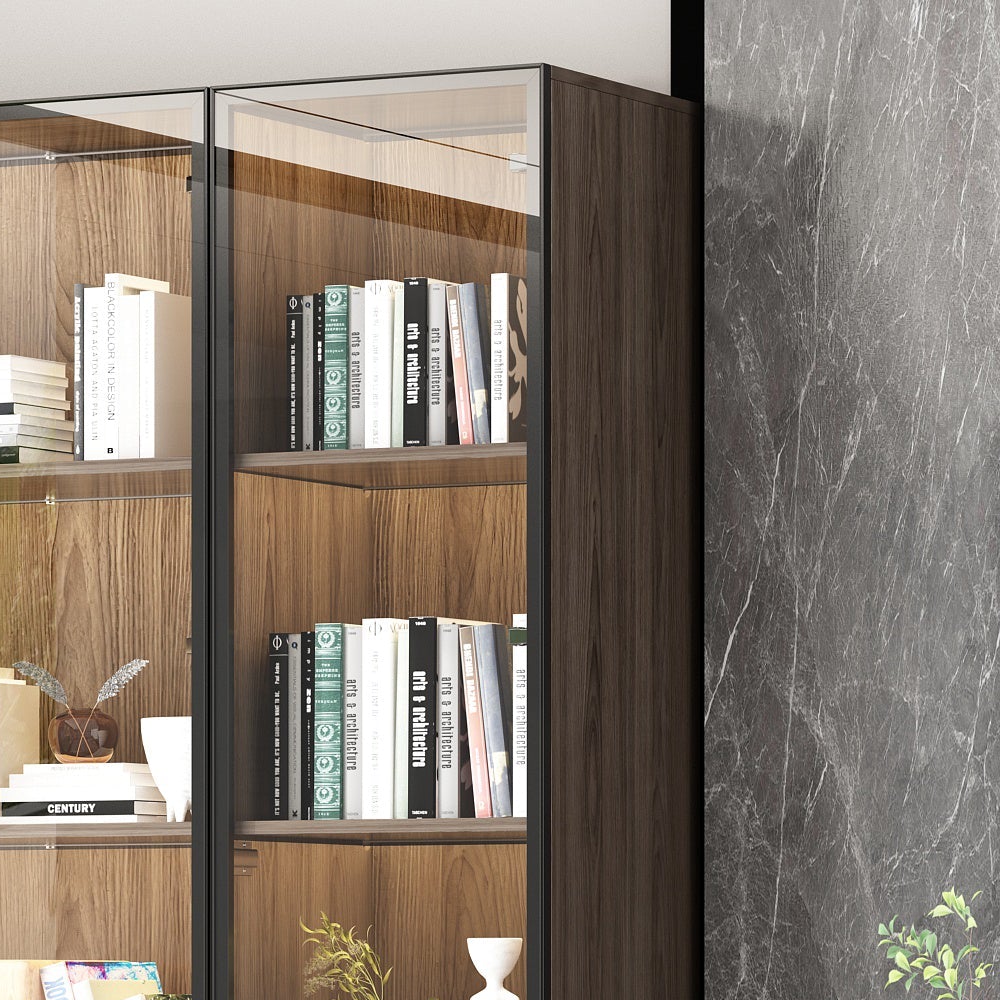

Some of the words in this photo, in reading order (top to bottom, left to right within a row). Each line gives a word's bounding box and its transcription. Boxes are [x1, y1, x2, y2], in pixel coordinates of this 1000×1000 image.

[107, 281, 116, 359] BLACKCOLOR
[352, 331, 361, 348] arts
[407, 322, 418, 341] arts
[432, 327, 441, 344] arts
[107, 363, 116, 375] IN
[352, 360, 362, 409] architecture
[407, 353, 419, 405] architecture
[432, 356, 443, 406] architecture
[494, 349, 504, 401] architecture
[107, 377, 116, 421] DESIGN
[347, 679, 357, 698] arts
[412, 671, 428, 690] arts
[442, 676, 452, 695] arts
[516, 669, 526, 688] arts
[347, 713, 359, 771] architecture
[412, 707, 430, 768] architecture
[442, 711, 454, 769] architecture
[516, 705, 527, 765] architecture
[47, 803, 96, 815] CENTURY
